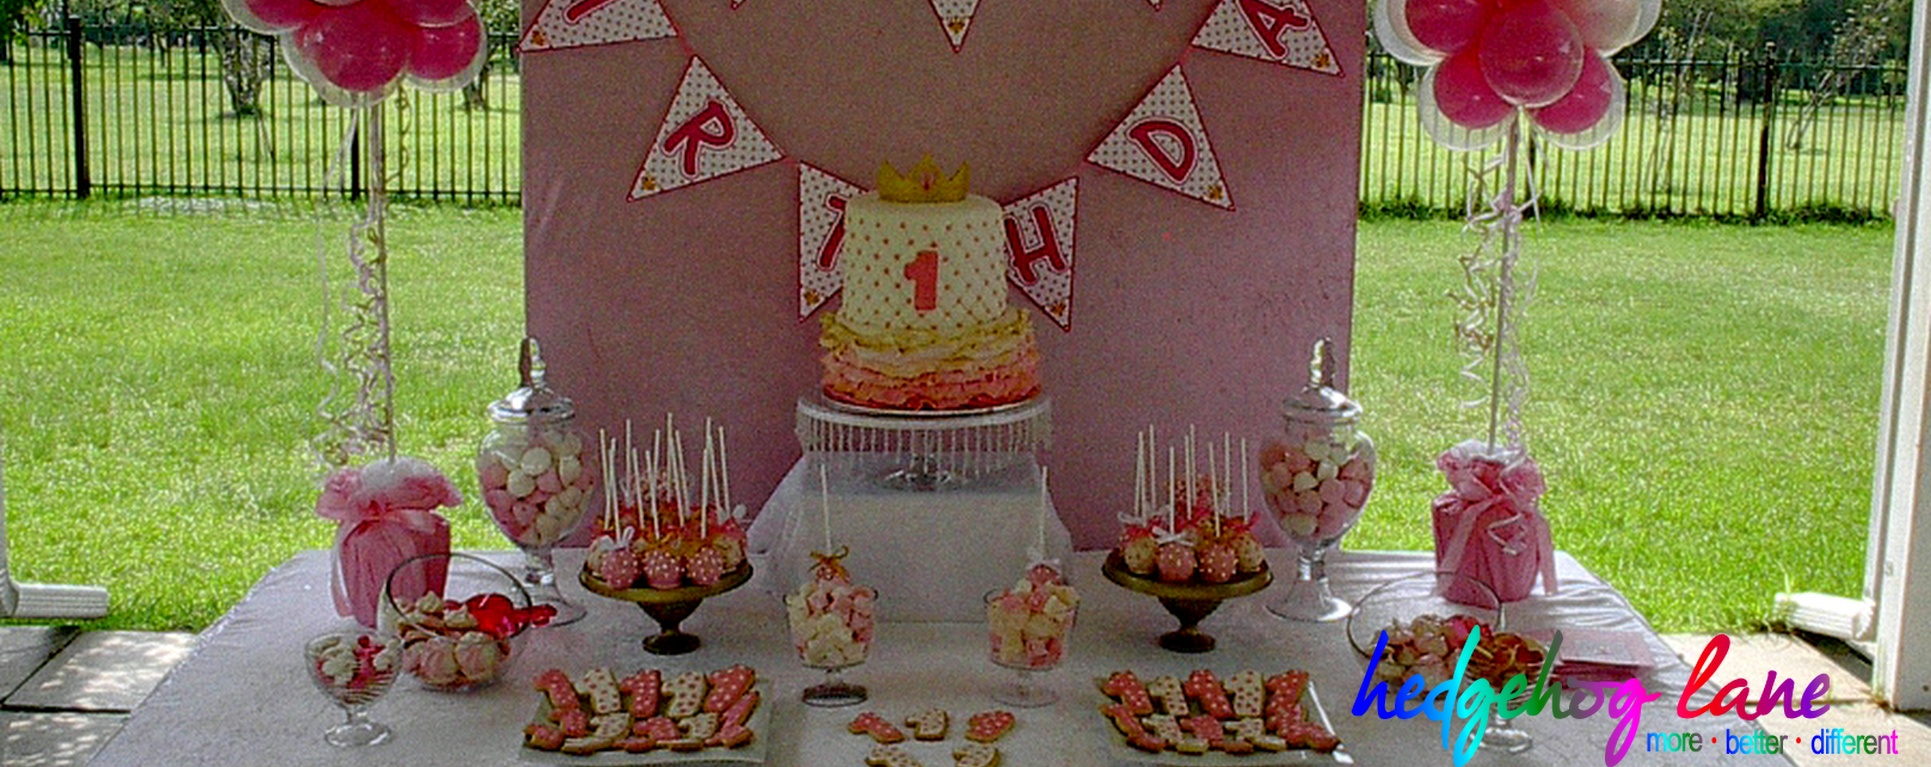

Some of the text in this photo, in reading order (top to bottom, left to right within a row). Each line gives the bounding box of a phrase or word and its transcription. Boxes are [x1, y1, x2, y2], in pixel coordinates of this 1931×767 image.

[663, 100, 735, 178] R
[1001, 203, 1069, 285] H
[1128, 117, 1198, 185] D
[904, 251, 939, 310] 1
